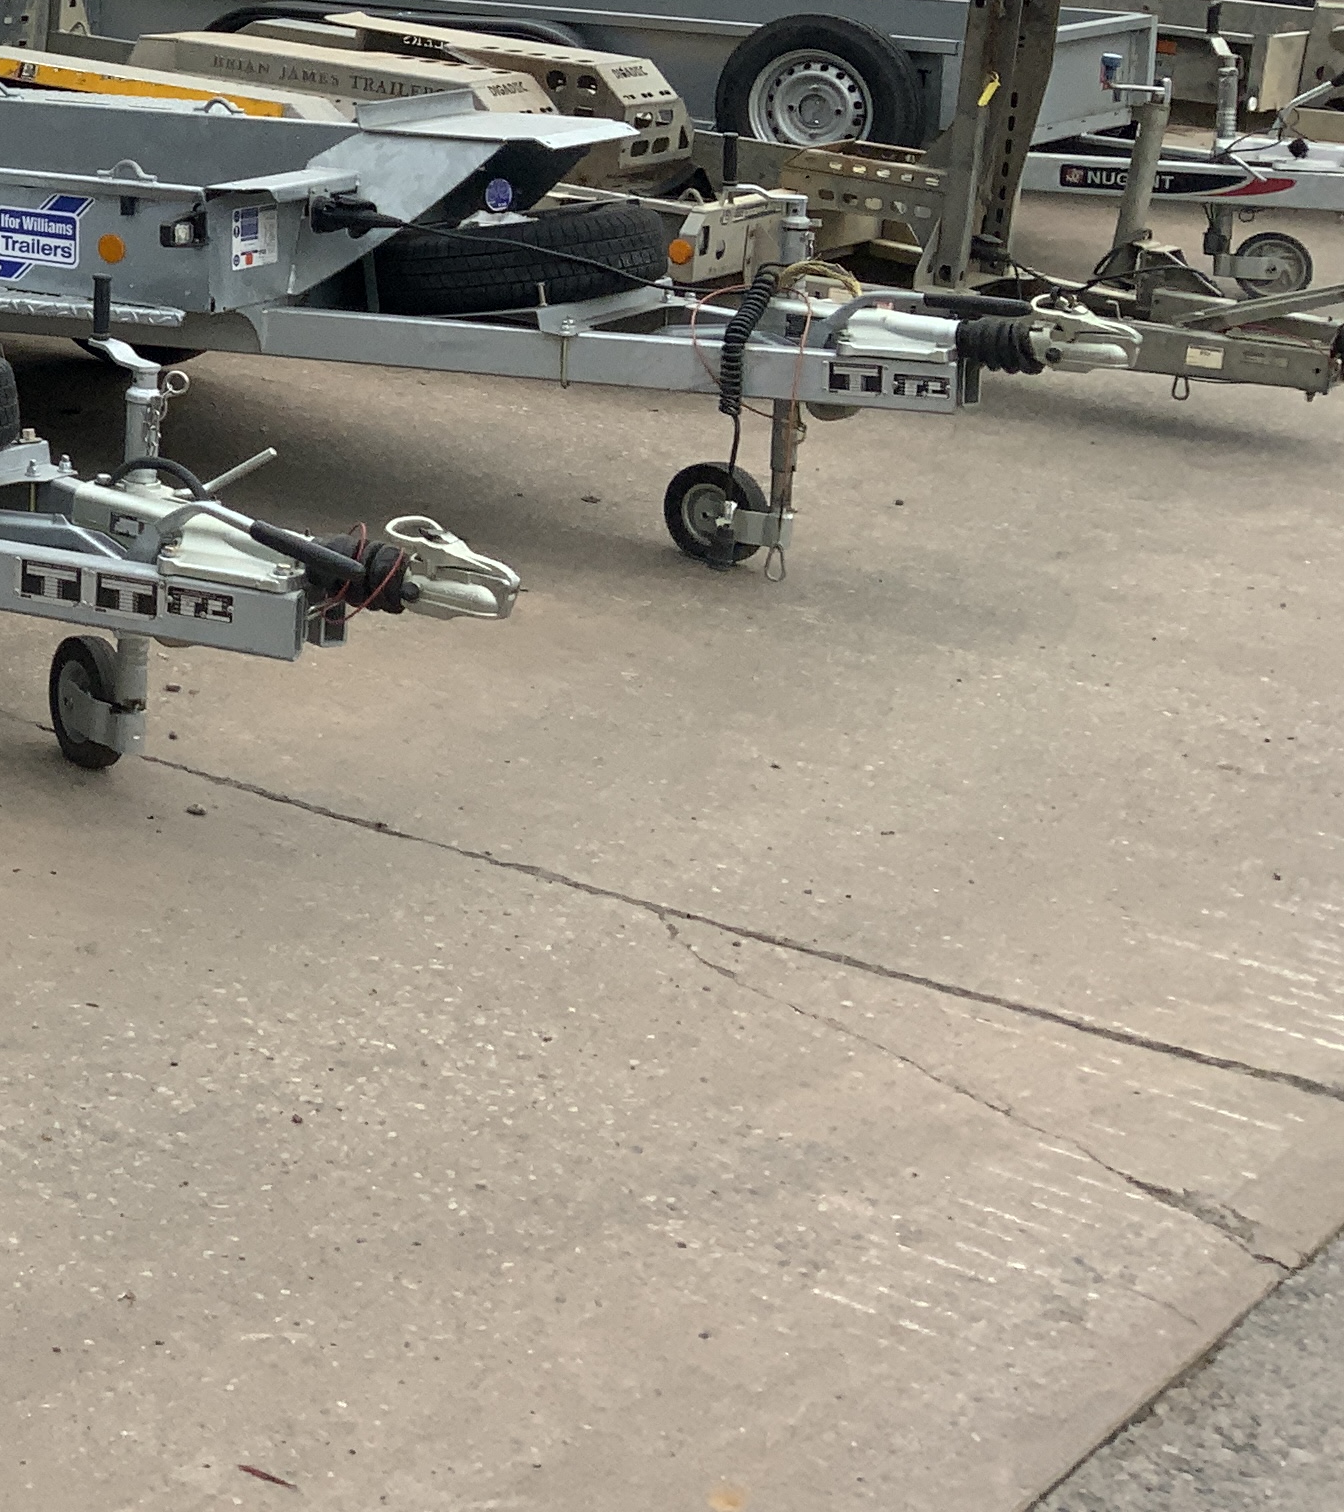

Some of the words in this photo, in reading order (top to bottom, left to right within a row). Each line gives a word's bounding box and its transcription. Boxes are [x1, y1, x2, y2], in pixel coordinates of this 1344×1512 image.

[0, 212, 21, 231] Ifor
[22, 215, 73, 236] Williams
[0, 234, 73, 259] Trailers
